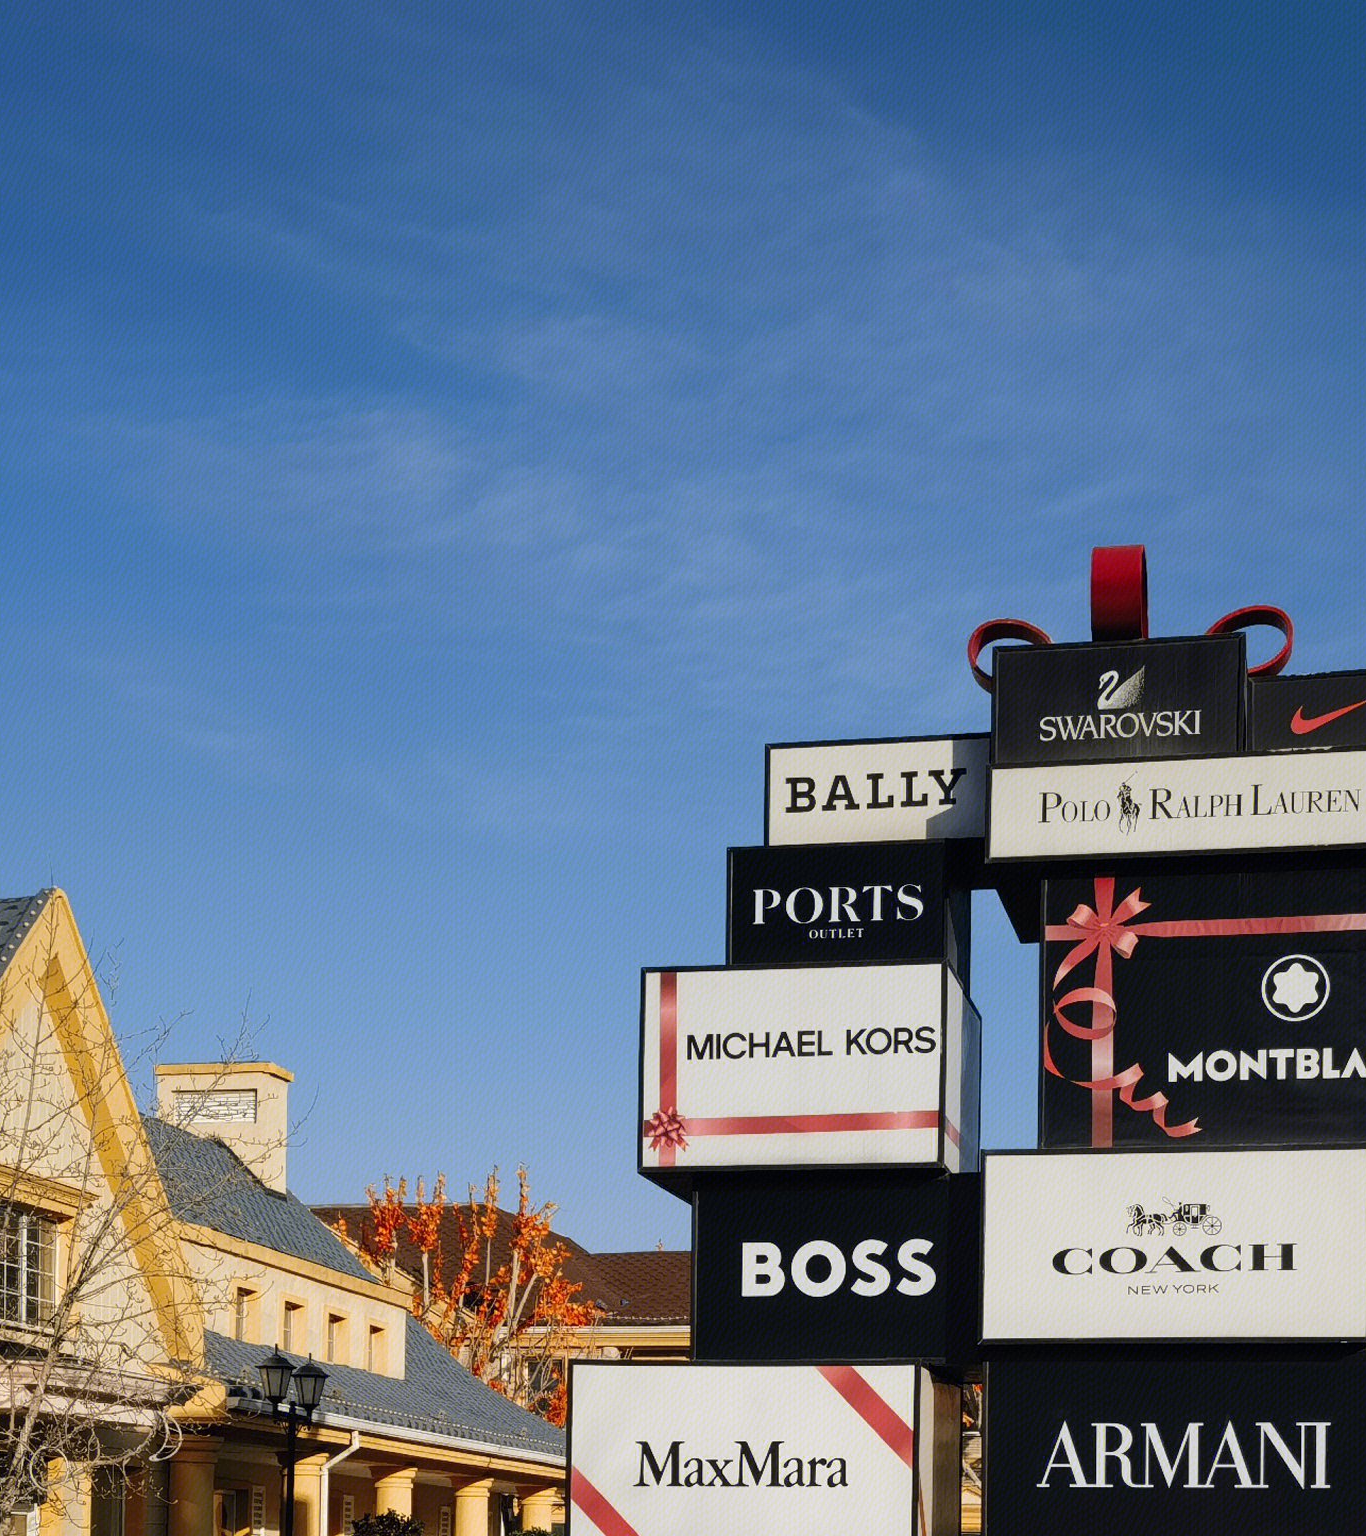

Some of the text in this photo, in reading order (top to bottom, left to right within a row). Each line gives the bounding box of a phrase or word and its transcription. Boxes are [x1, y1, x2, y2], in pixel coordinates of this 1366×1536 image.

[1039, 709, 1202, 742] SWAROVSKI
[785, 767, 967, 813] BALLY
[751, 883, 924, 925] PORTS
[808, 927, 865, 940] OUTLET
[686, 1025, 937, 1061] MICHAEL KORS
[740, 1237, 938, 1298] BOSS
[1051, 1242, 1298, 1276] COACH
[1127, 1282, 1220, 1296] NEW YORK
[632, 1439, 849, 1489] MaxMara
[1036, 1419, 1333, 1491] ARMANI
